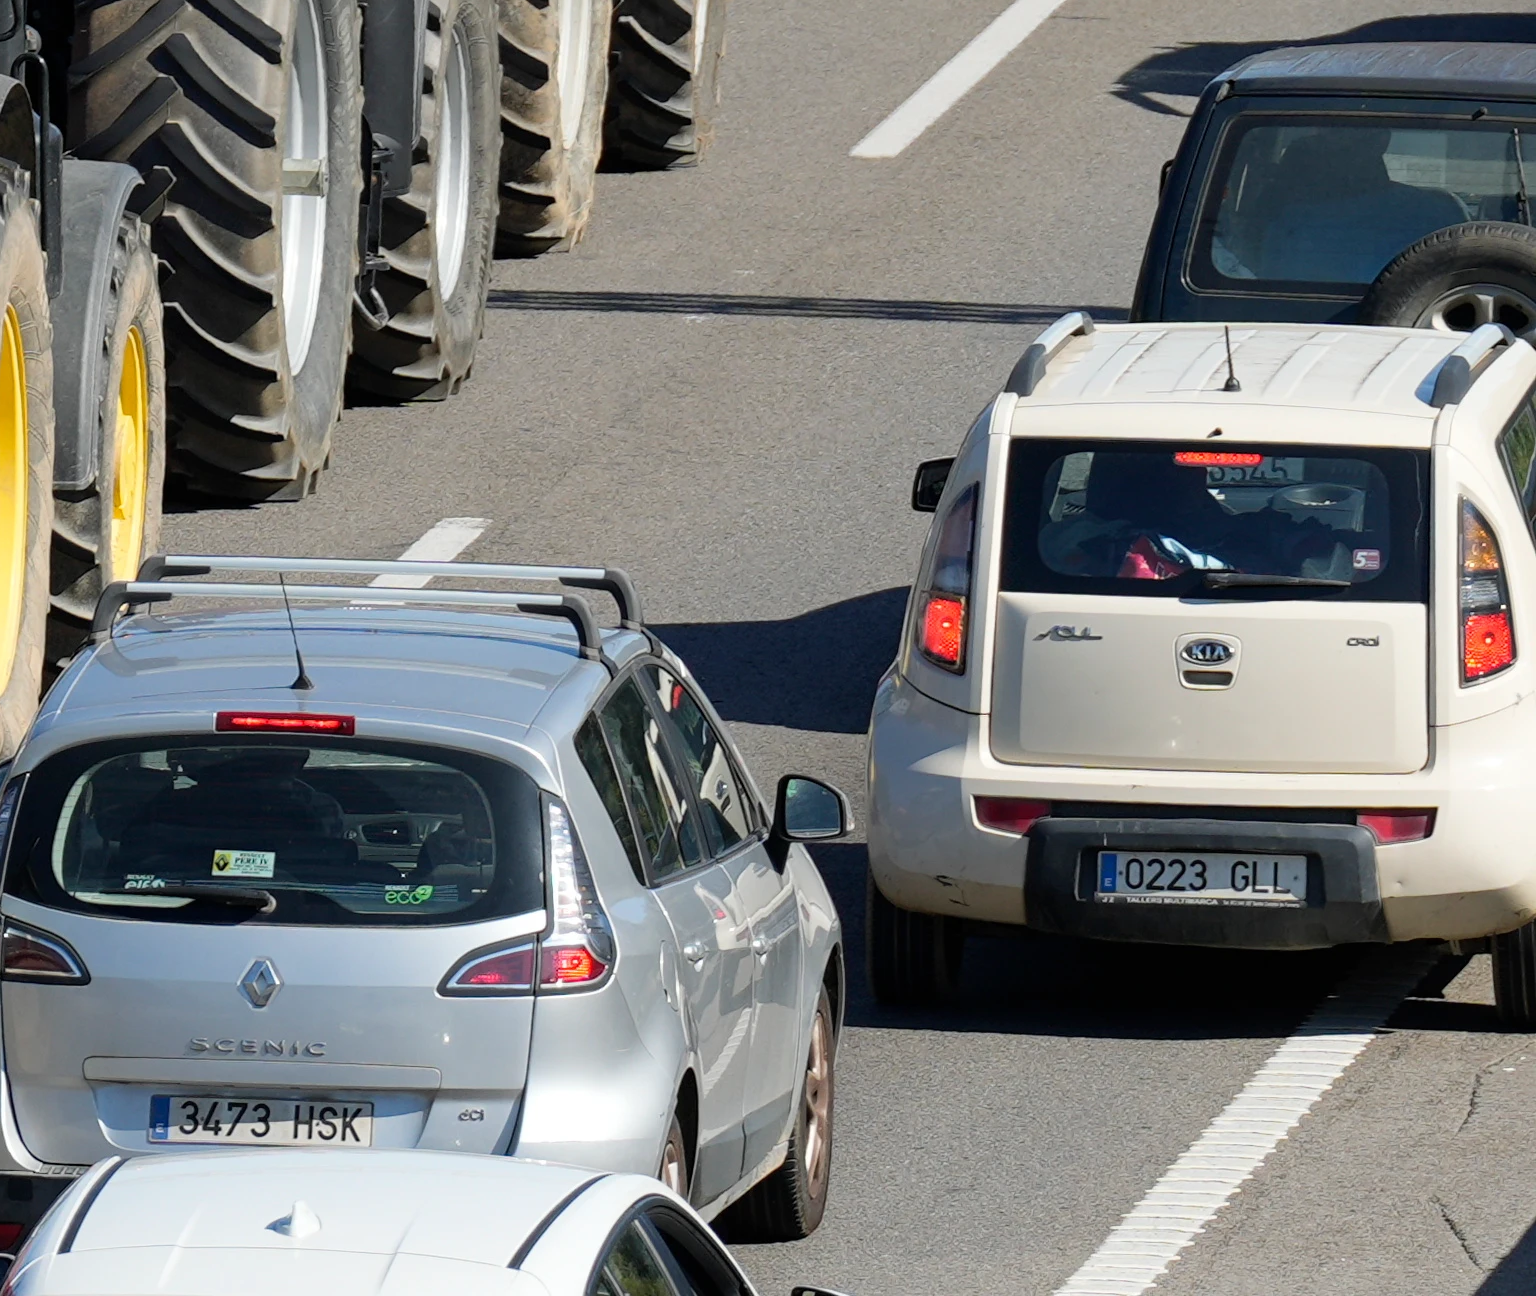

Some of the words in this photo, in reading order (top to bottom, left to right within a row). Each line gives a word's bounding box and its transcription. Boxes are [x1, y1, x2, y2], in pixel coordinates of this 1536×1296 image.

[1190, 644, 1227, 661] KIA
[1125, 858, 1207, 891] 0223
[1230, 861, 1291, 894] GLL
[189, 1037, 328, 1057] SCENIC
[178, 1100, 272, 1138] 3473
[293, 1104, 363, 1143] HSK
